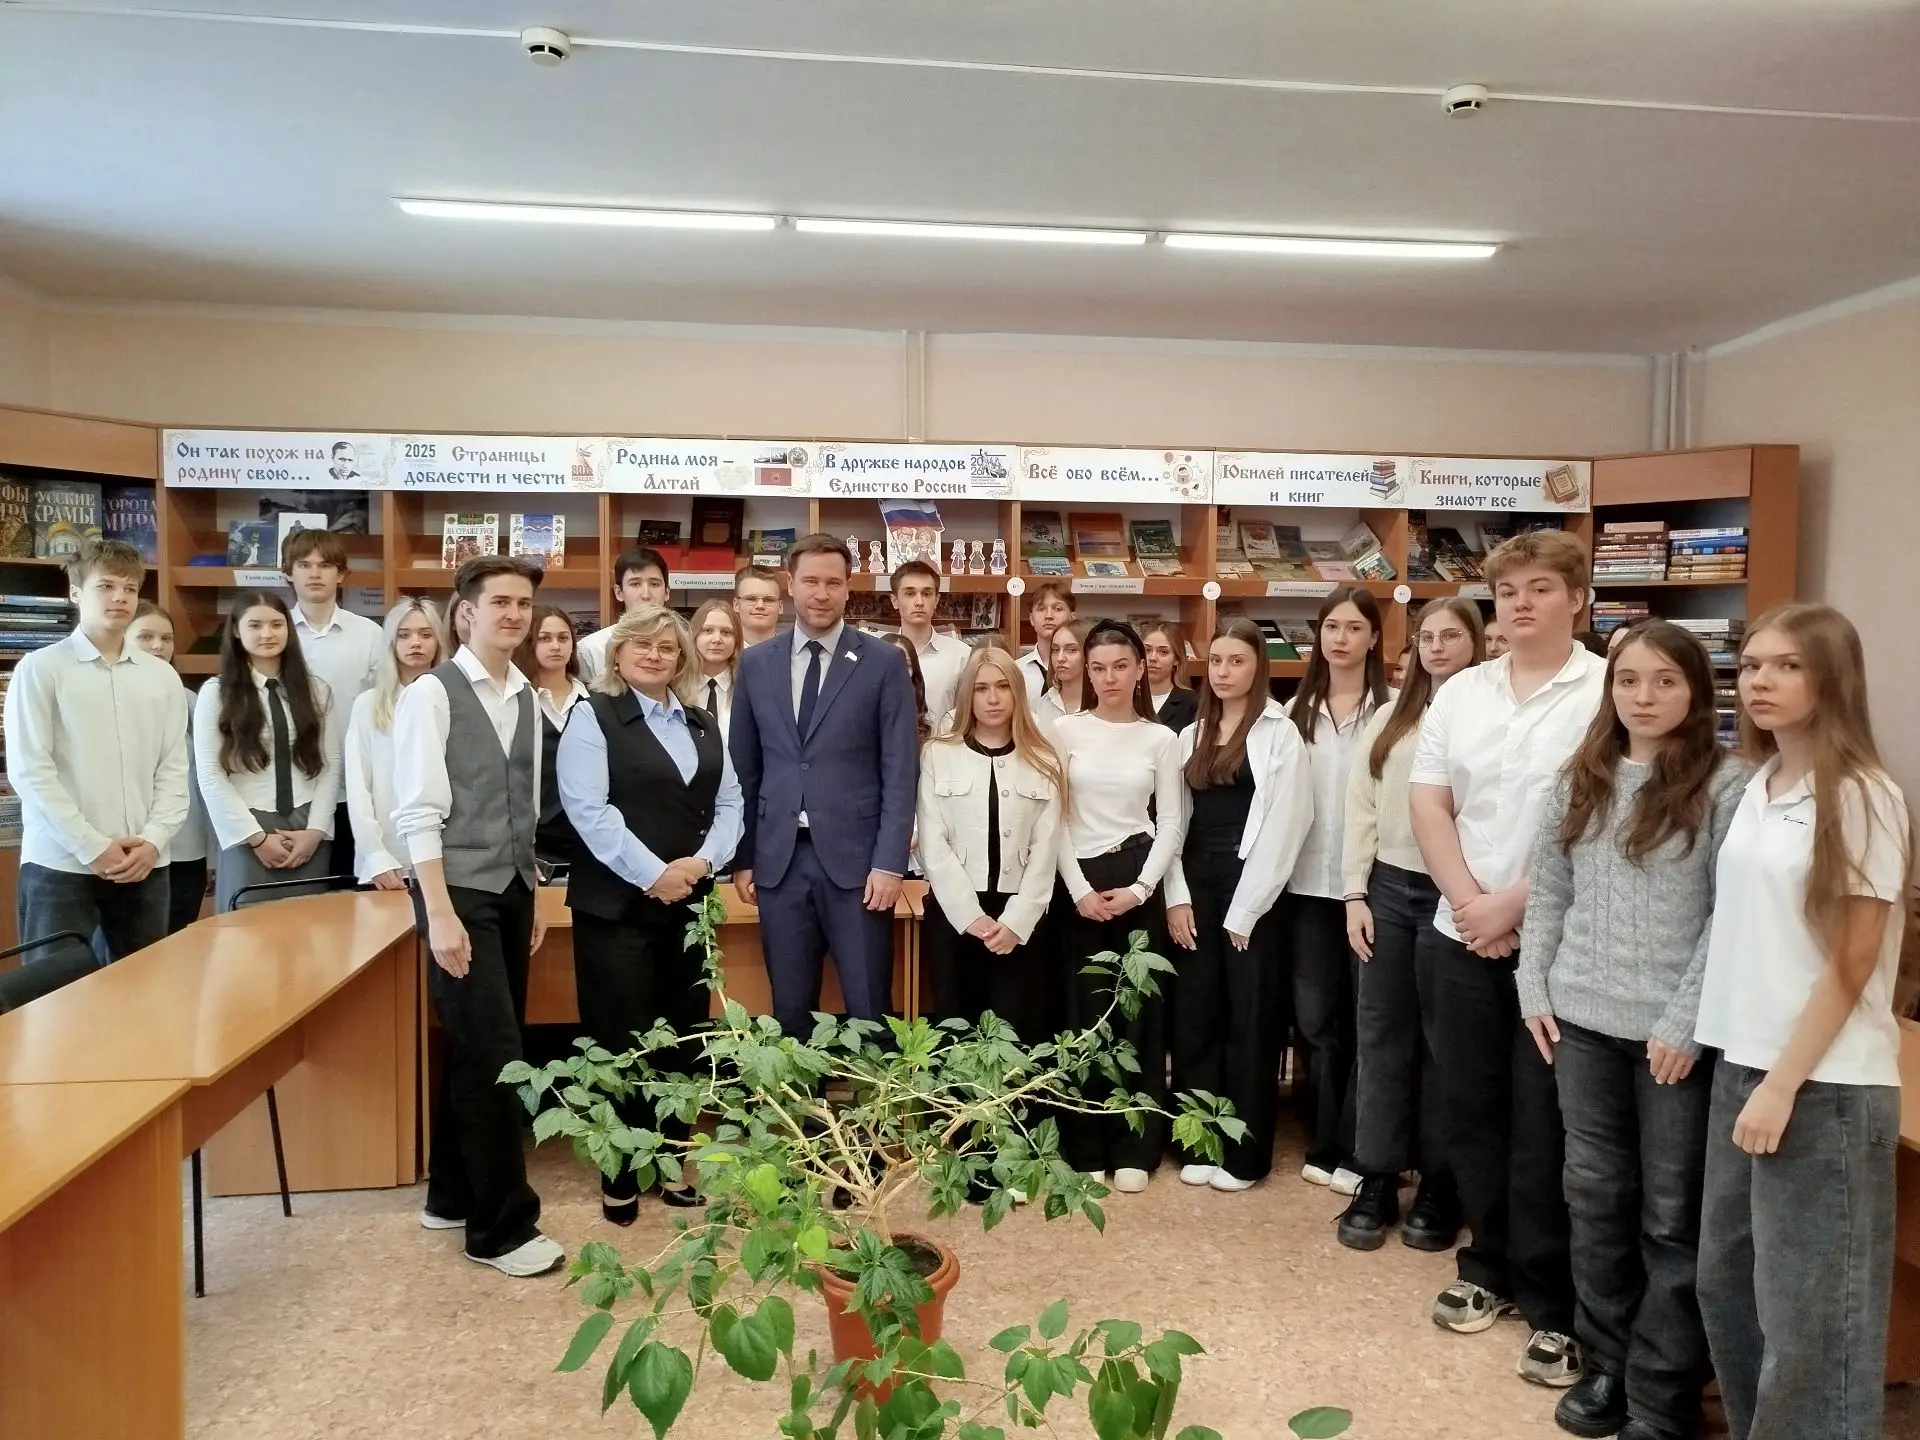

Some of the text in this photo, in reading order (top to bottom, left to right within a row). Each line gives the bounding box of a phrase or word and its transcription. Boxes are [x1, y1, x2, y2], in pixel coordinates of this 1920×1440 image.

[177, 442, 325, 464] Он так похож на
[404, 443, 436, 458] 2025
[451, 445, 546, 466] Страницы
[616, 448, 680, 468] Родина
[684, 454, 719, 467] моя
[825, 453, 966, 473] В дружбе народов
[178, 466, 311, 484] родину свою...
[403, 471, 566, 486] доблести и чести
[1028, 463, 1159, 482] Всё обо всём...
[1222, 464, 1371, 482] Юбилей писателей
[1419, 469, 1542, 490] Книги, которые
[643, 473, 700, 491] Алтай
[829, 478, 967, 495] Единство России
[0, 484, 30, 504] ФЫ
[34, 489, 96, 506] УССКИЕ
[1269, 491, 1325, 503] и книг
[1435, 495, 1518, 508] знают все
